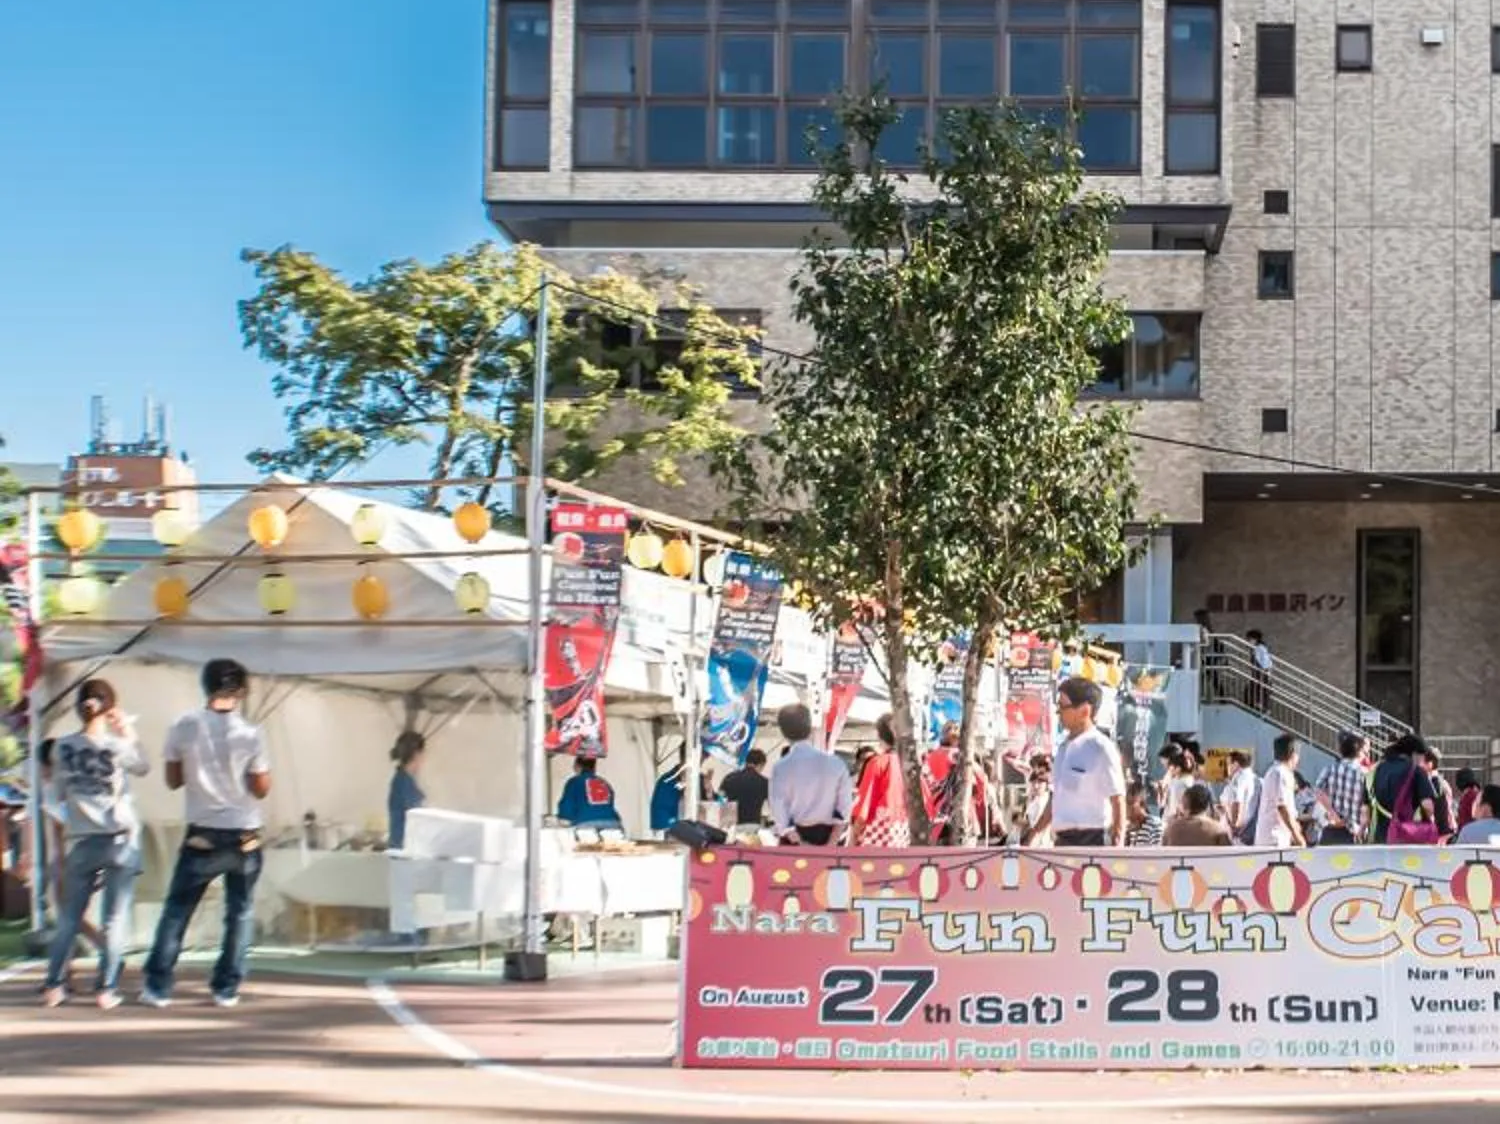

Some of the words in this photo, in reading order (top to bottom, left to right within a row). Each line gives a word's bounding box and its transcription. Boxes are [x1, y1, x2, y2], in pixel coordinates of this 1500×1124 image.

[710, 903, 839, 935] Nara
[849, 896, 1056, 954] Fun
[1081, 896, 1287, 954] Fun
[1407, 966, 1449, 981] Nara
[1455, 966, 1496, 981] "Fun
[702, 989, 729, 1005] On
[737, 989, 806, 1005] August
[1410, 995, 1487, 1013] Venue:
[838, 1040, 948, 1060] Omatsuri
[956, 1040, 1018, 1060] Food
[1028, 1040, 1099, 1060] Stalls
[1109, 1040, 1152, 1060] and
[1161, 1040, 1242, 1059] Games
[1275, 1039, 1396, 1058] 16:00-21:00
